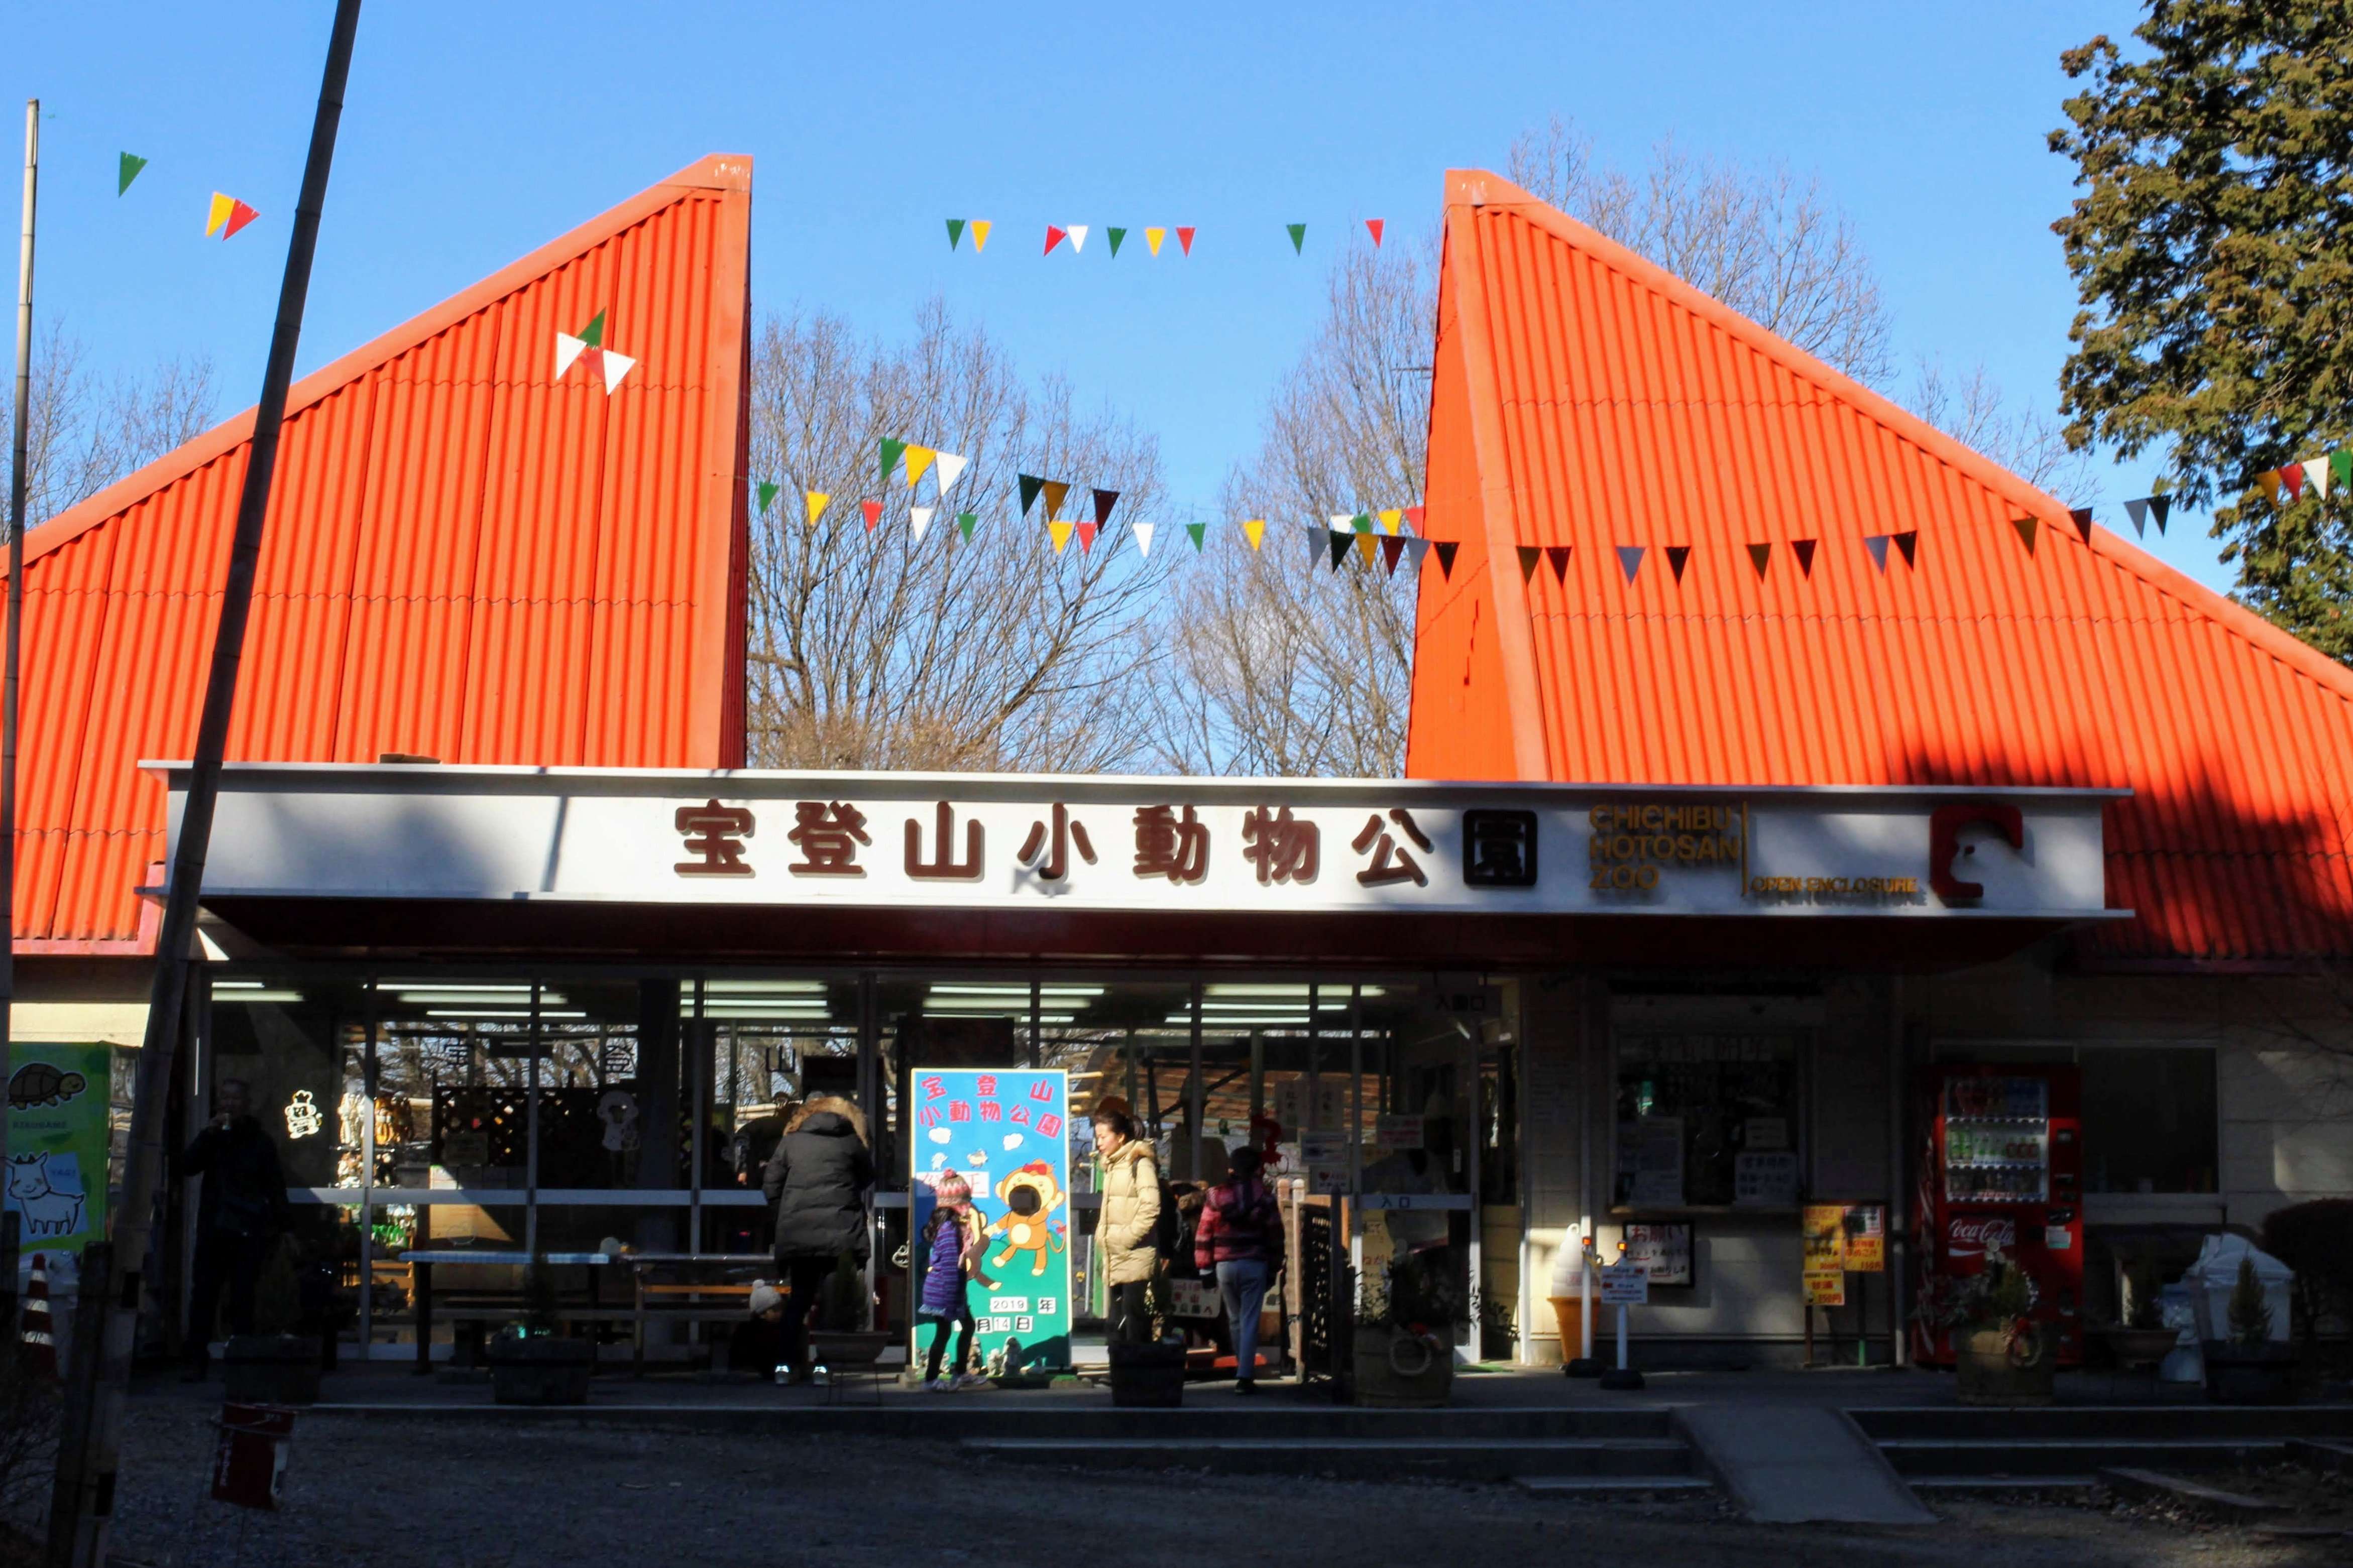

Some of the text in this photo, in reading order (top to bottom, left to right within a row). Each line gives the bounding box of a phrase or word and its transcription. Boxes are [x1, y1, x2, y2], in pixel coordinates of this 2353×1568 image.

[1589, 804, 1733, 831] CHICHIBU
[674, 798, 1538, 888] 宝登山小動物公園
[1589, 833, 1740, 861] HOTOSAN
[1589, 863, 1660, 891] ZOO
[1750, 875, 1918, 895] OPEN ENCLOSURE
[920, 1074, 1054, 1103] 宝登山
[918, 1100, 1064, 1139] 小動物公園
[1381, 1196, 1410, 1208] 入口
